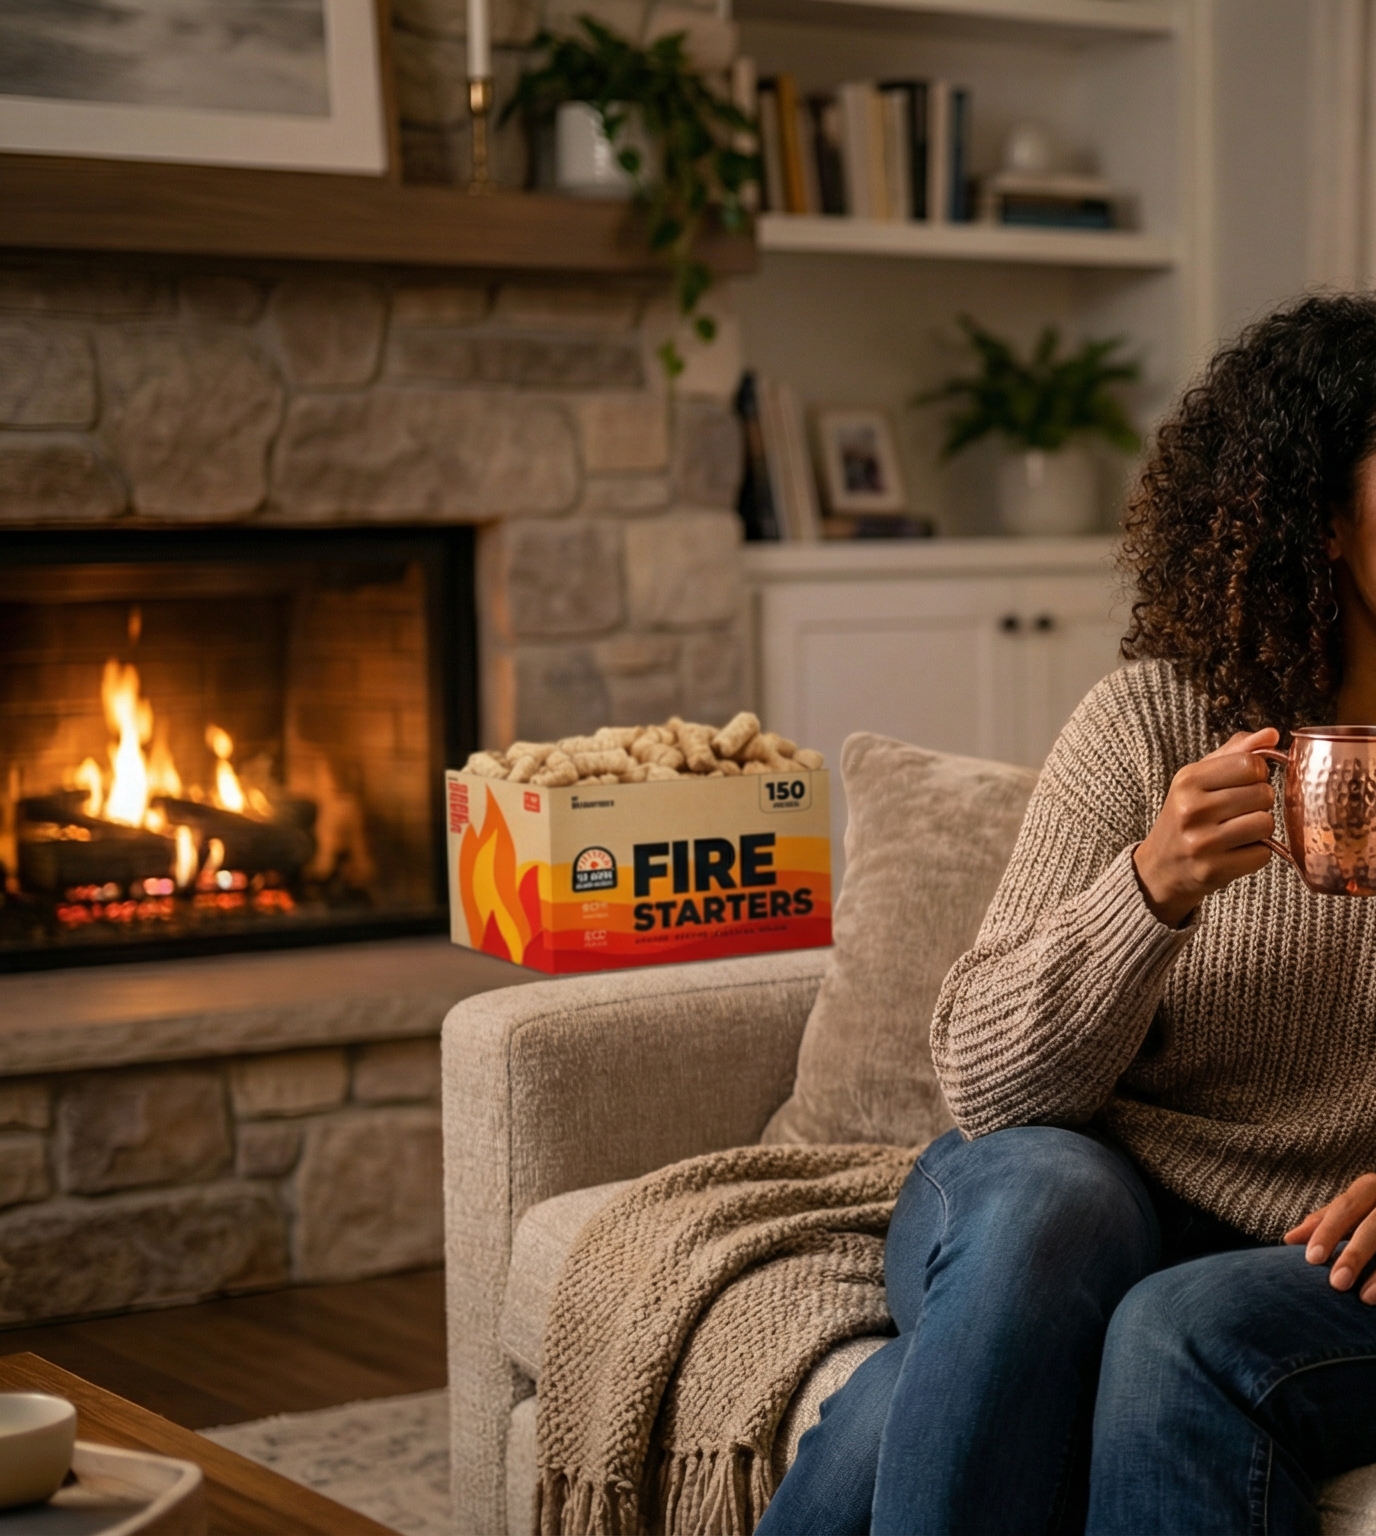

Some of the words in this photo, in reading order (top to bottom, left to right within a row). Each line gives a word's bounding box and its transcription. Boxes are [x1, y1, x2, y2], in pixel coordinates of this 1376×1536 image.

[765, 780, 805, 801] 150
[633, 832, 777, 898] FIRE
[633, 888, 814, 932] STARTERS
